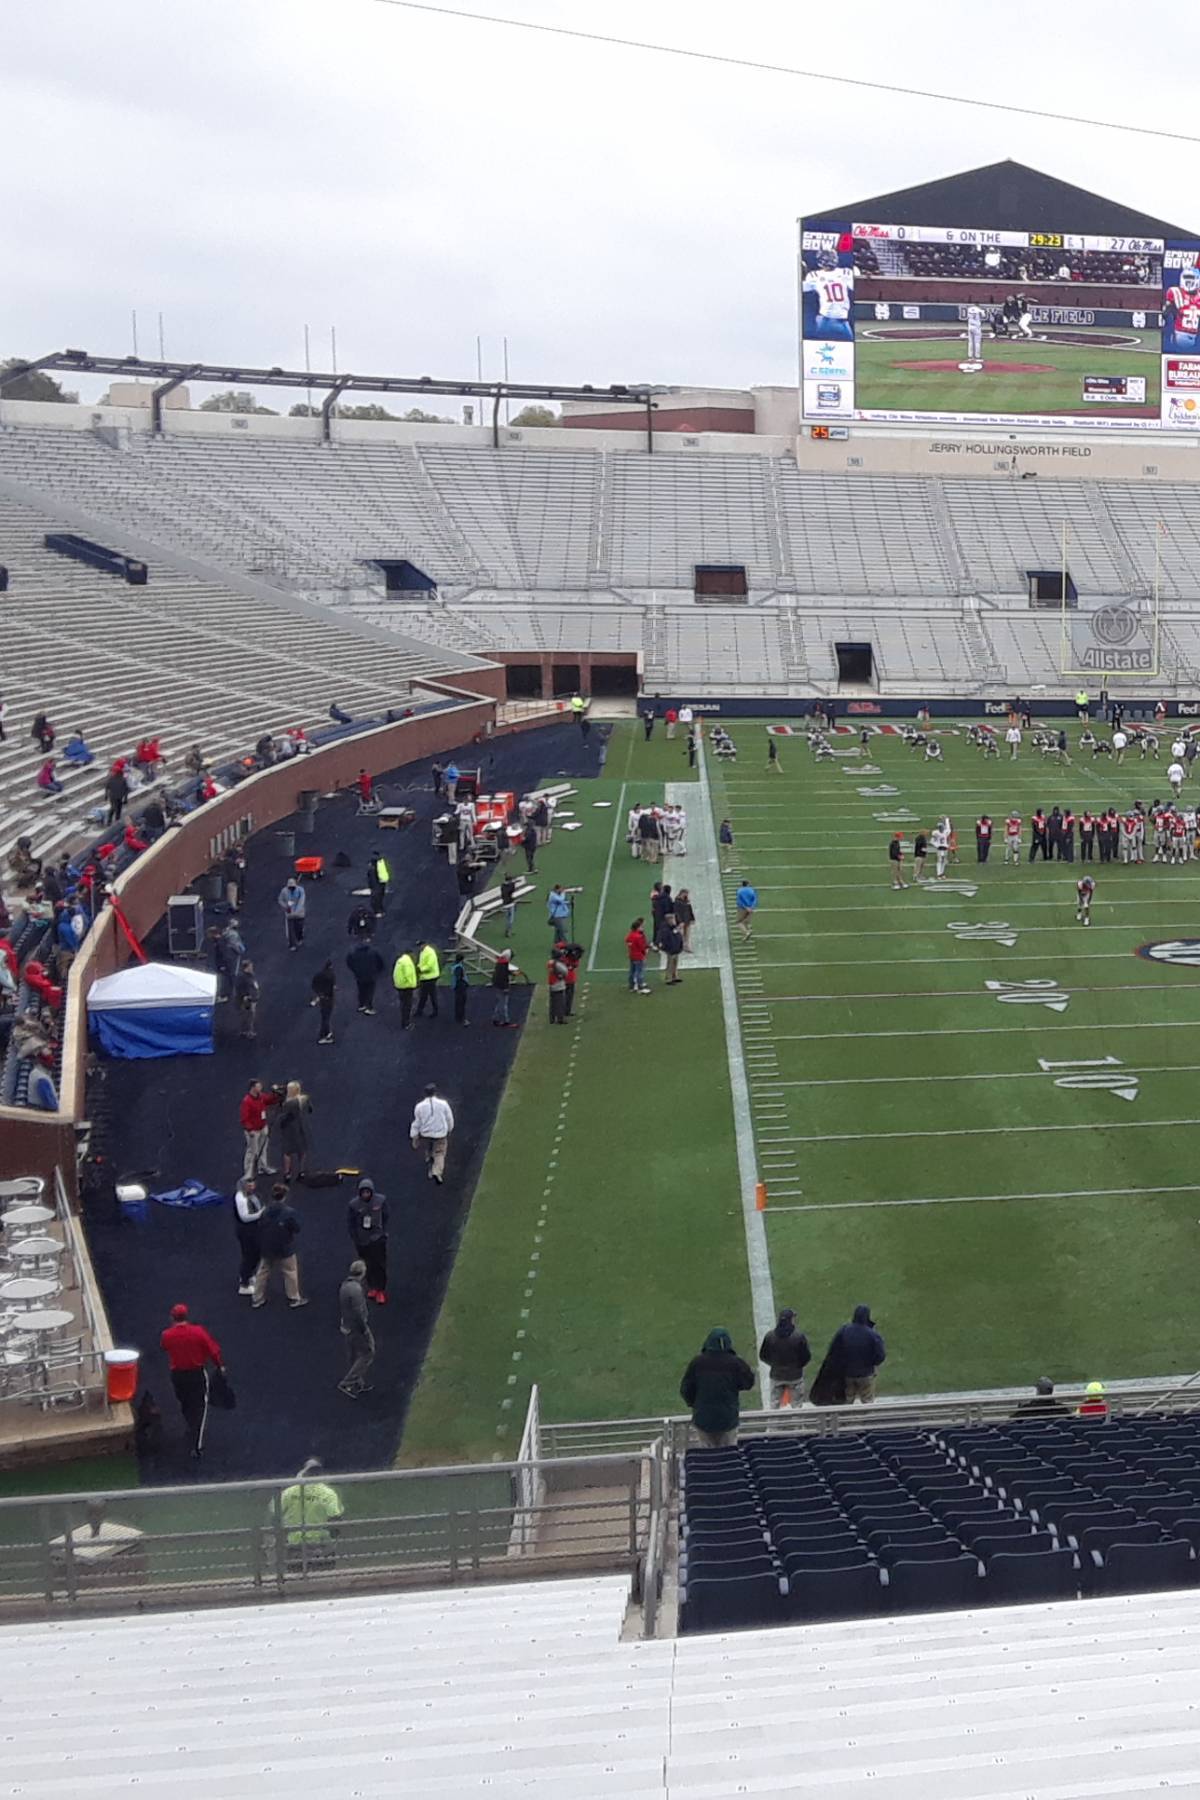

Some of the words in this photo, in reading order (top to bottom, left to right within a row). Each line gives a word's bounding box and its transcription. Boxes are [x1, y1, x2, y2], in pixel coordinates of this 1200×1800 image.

[960, 231, 977, 241] ON
[979, 232, 1001, 243] THE
[1111, 238, 1126, 250] 27
[823, 283, 844, 303] 10
[1051, 309, 1095, 325] FIELD
[812, 426, 829, 439] 25
[929, 443, 962, 454] JERRY
[966, 444, 1059, 457] HOLLINGSWORTH
[1062, 446, 1092, 458] FIELD
[1082, 649, 1151, 669] Allstate
